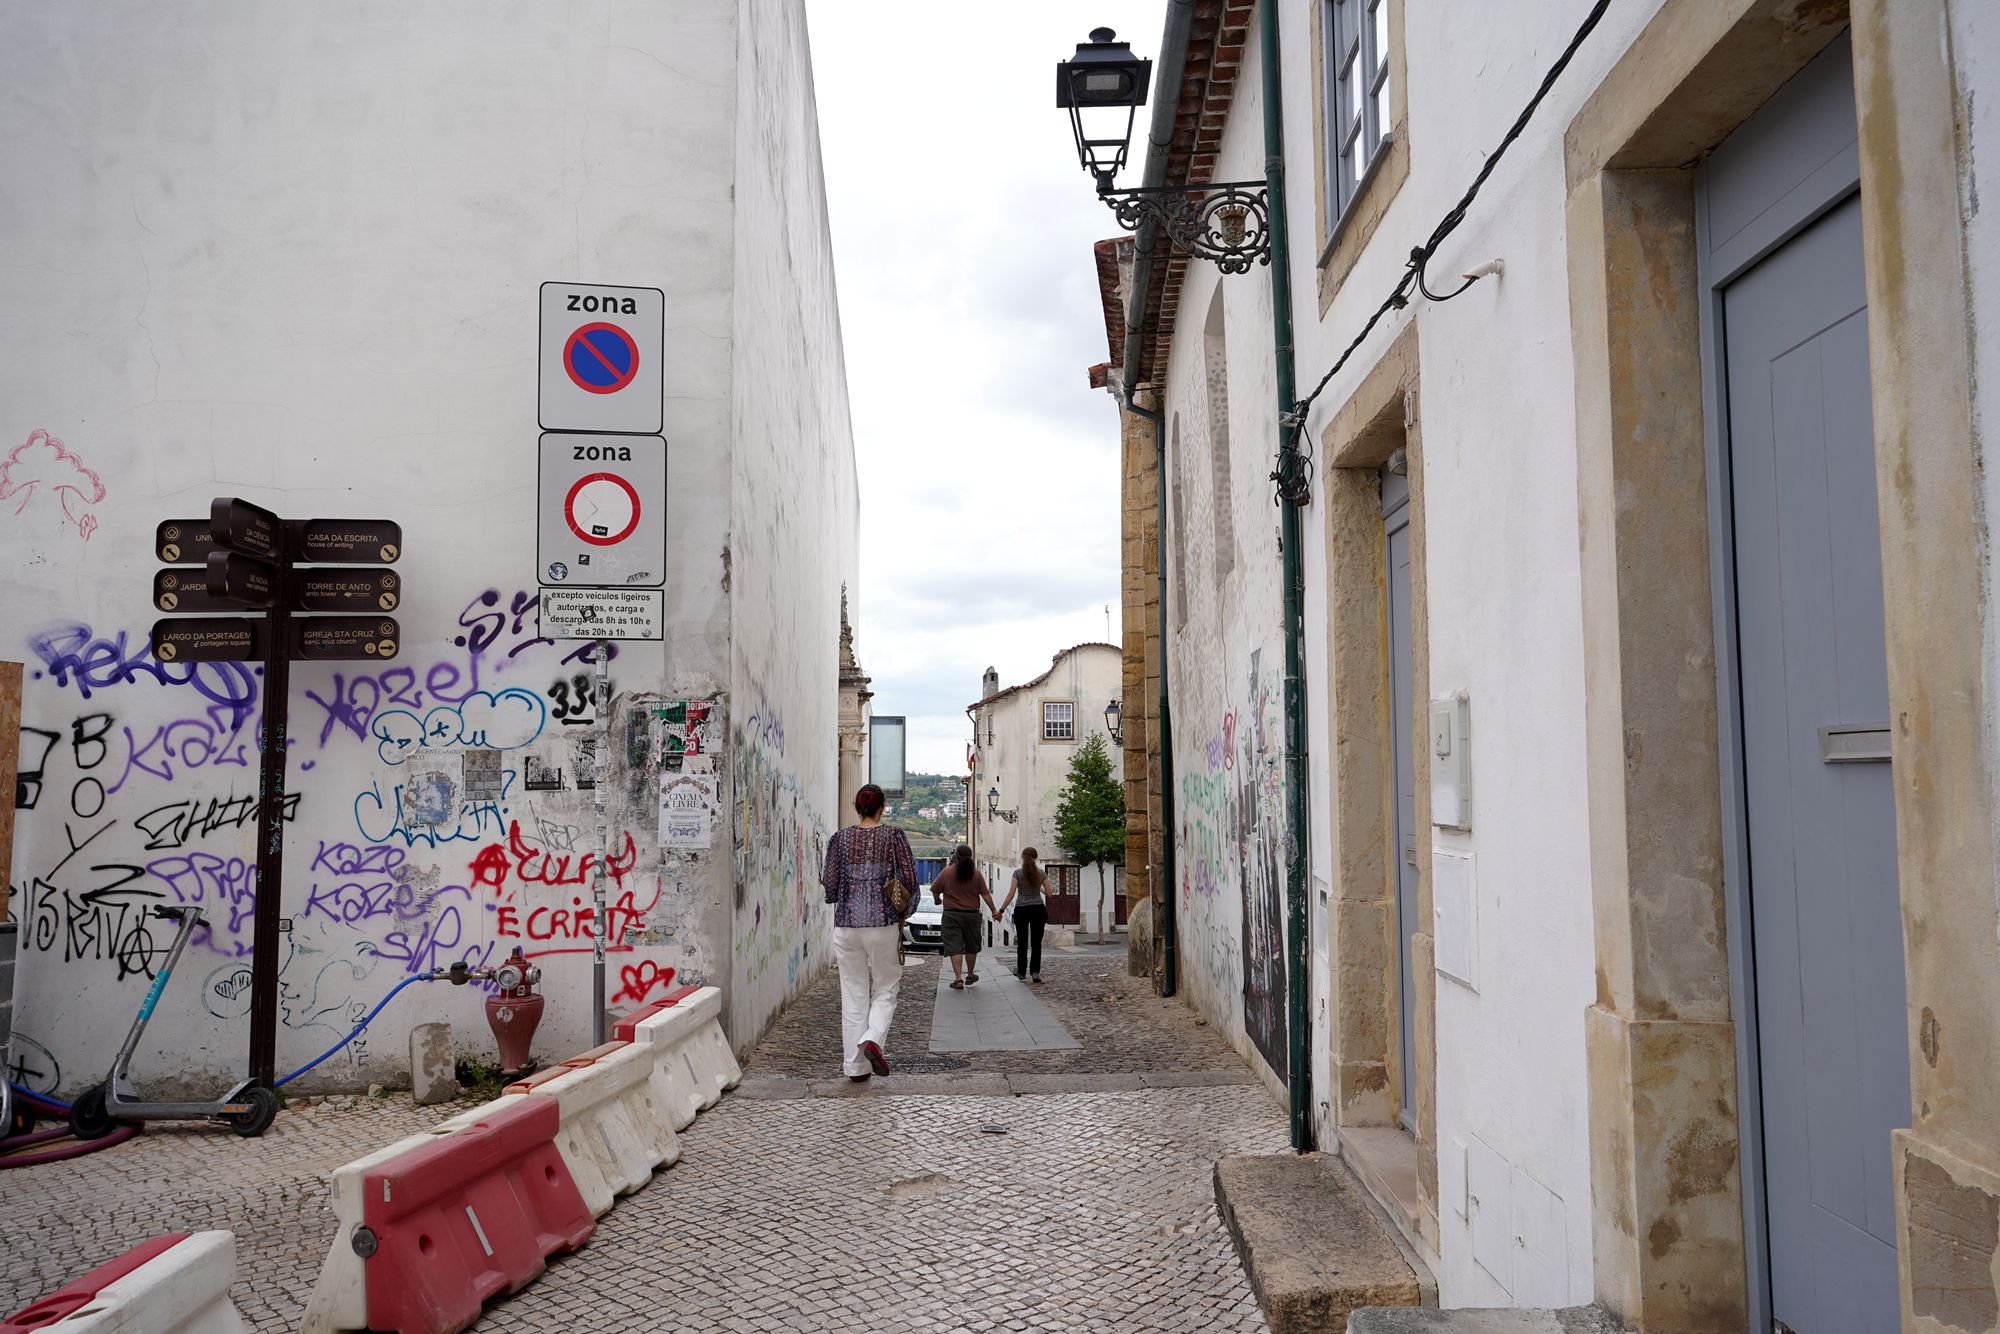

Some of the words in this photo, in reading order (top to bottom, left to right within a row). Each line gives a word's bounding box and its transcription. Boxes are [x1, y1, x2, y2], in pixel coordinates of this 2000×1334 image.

[567, 294, 637, 315] zona
[573, 446, 632, 462] zona
[344, 534, 379, 542] ESCRITA
[335, 583, 347, 591] DE
[348, 583, 371, 591] ANTO
[551, 591, 584, 601] excepto
[620, 592, 651, 602] ligeiros
[615, 605, 639, 614] carga
[605, 616, 616, 624] 8h
[630, 616, 644, 625] 10h
[304, 631, 333, 639] IGREJA
[351, 630, 375, 638] CRUZ
[575, 627, 590, 636] das
[592, 628, 607, 636] 20h
[615, 628, 626, 637] 1h
[163, 633, 192, 641] LARGO
[669, 793, 703, 801] CINEMA
[672, 800, 700, 808] LIVRE
